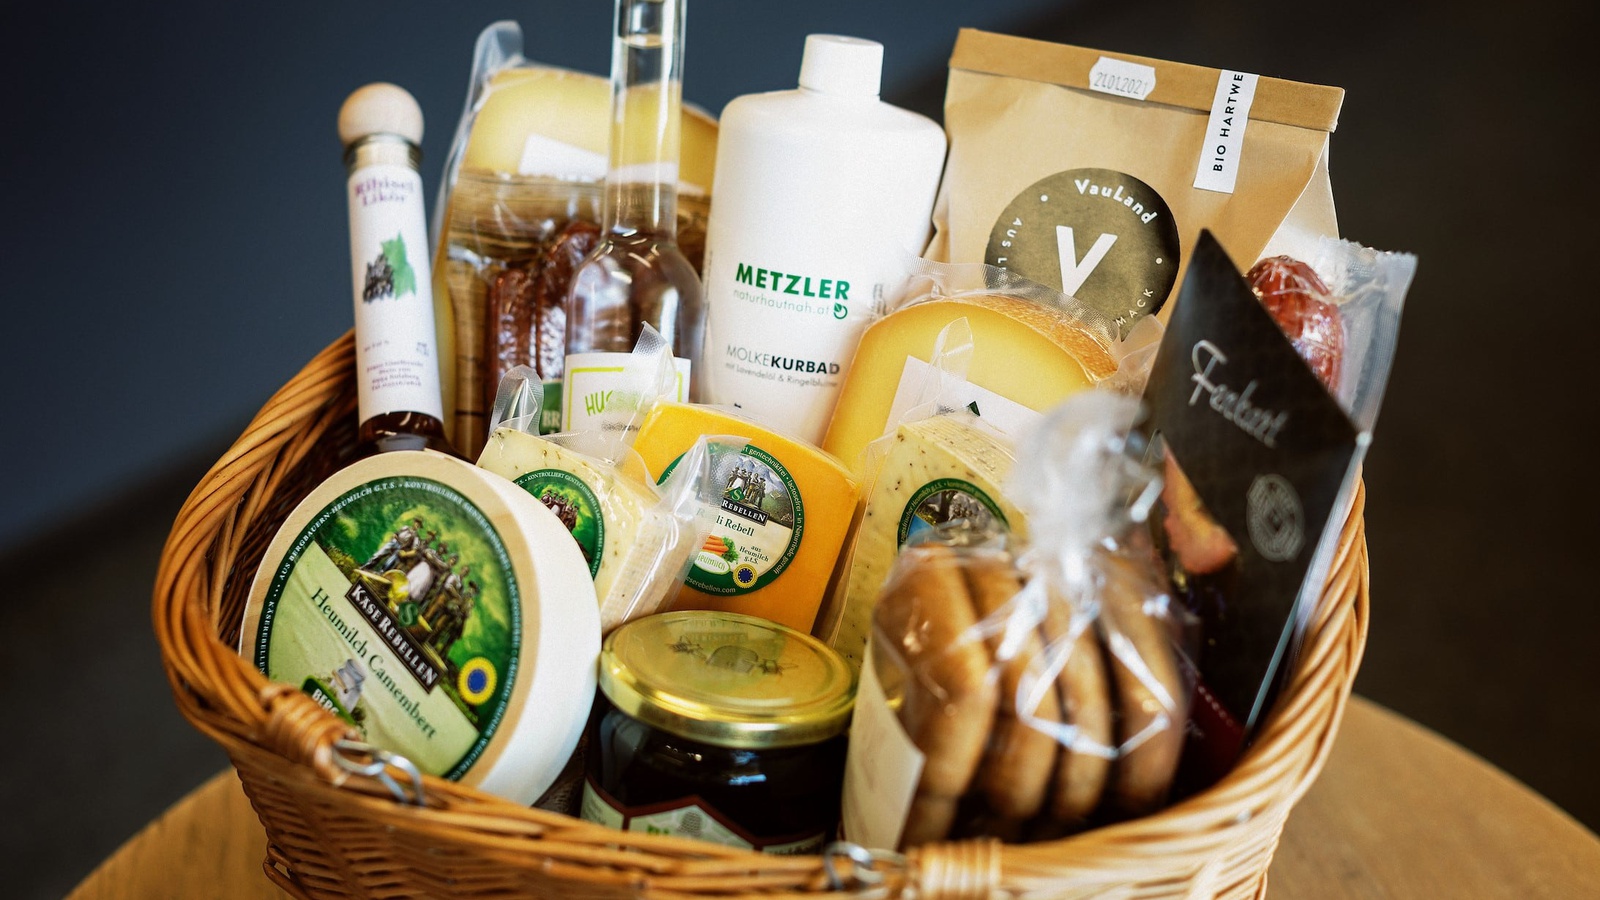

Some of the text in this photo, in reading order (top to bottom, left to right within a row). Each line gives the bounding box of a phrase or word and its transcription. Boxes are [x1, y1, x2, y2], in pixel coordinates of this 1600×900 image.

[1213, 73, 1244, 172] BIO HARTWE
[1074, 178, 1158, 225] VauLand
[1001, 217, 1023, 248] AUS
[1055, 224, 1119, 298] V
[735, 262, 851, 301] METZLER
[733, 288, 831, 316] naturhautnah.at
[726, 344, 841, 375] MOLKEKURBAD
[736, 365, 776, 381] Lavendelöl
[777, 373, 785, 382] &
[527, 471, 565, 481] KONTROLLIERT
[721, 499, 766, 522] REBELLEN
[748, 448, 803, 575] gentechnikfrei lactosefrei in Naturrinde gereift
[279, 562, 292, 581] AUS
[288, 486, 373, 563] BERGBAUERN-HEUMILCH
[373, 480, 397, 493] G.T.S.
[724, 518, 755, 537] Rebell
[739, 545, 769, 563] Heumilch
[751, 545, 762, 553] aus
[351, 584, 438, 686] KÄSE REBELLEN
[310, 587, 437, 740] Heumilch Camembert
